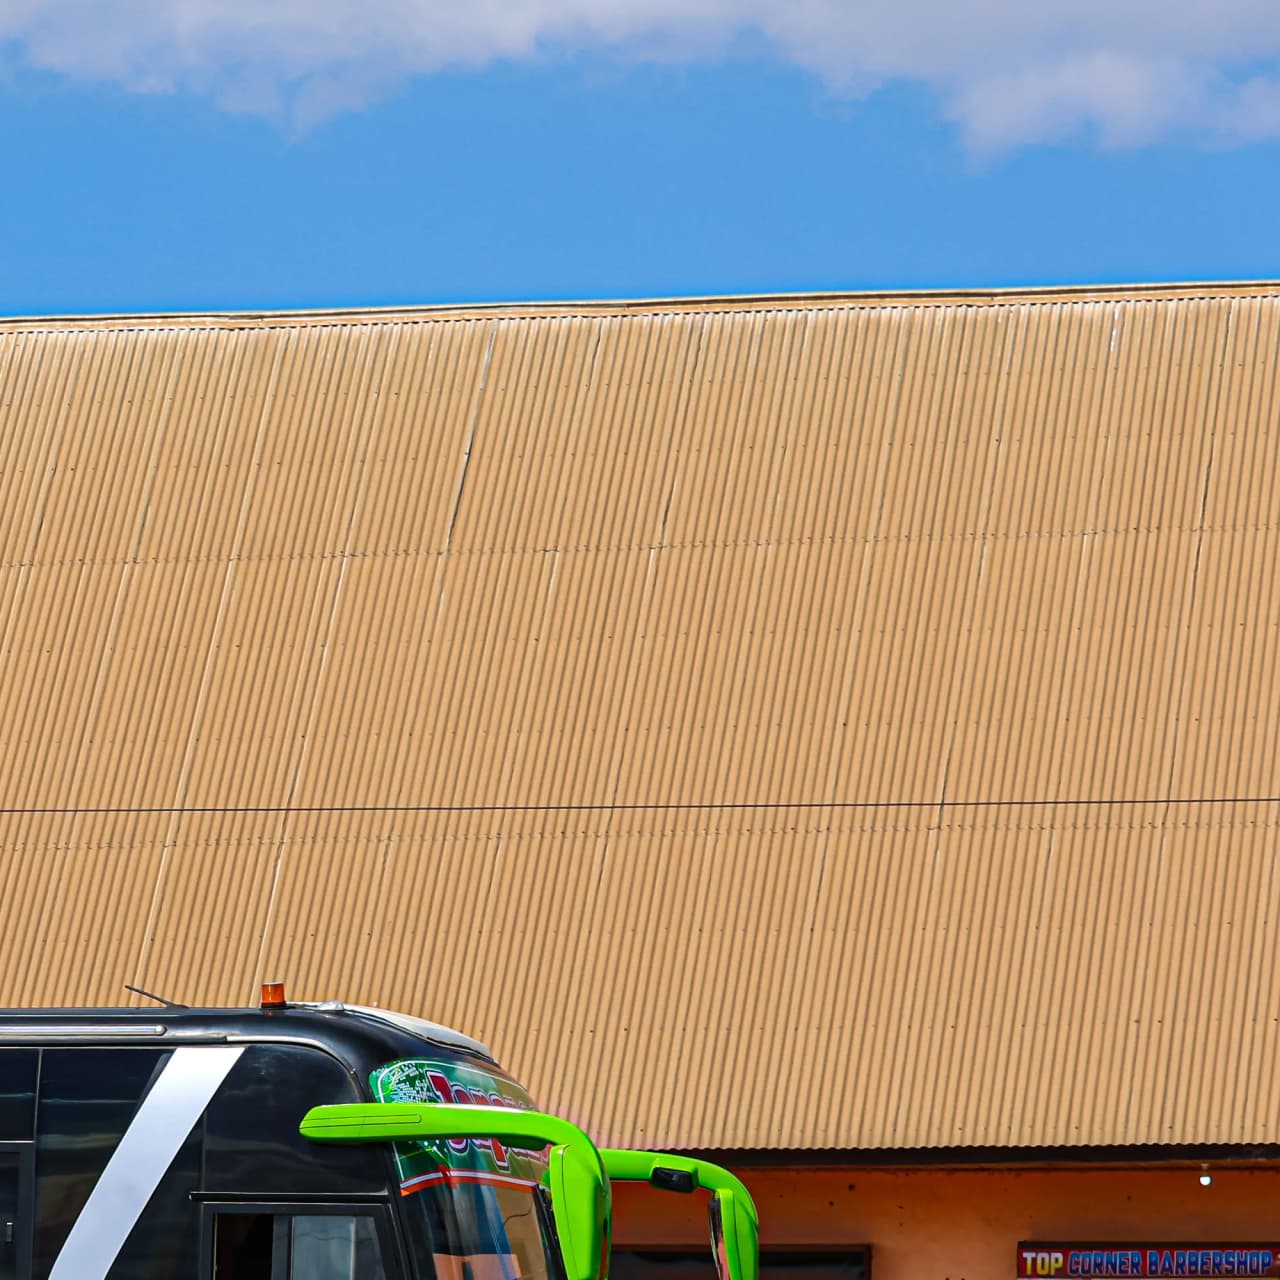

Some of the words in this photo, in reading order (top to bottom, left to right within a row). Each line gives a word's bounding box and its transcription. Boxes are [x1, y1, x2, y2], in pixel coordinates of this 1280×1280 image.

[1022, 1251, 1064, 1276] TOP
[1068, 1251, 1143, 1277] CORNER
[1147, 1250, 1273, 1277] BARBERSHOP
